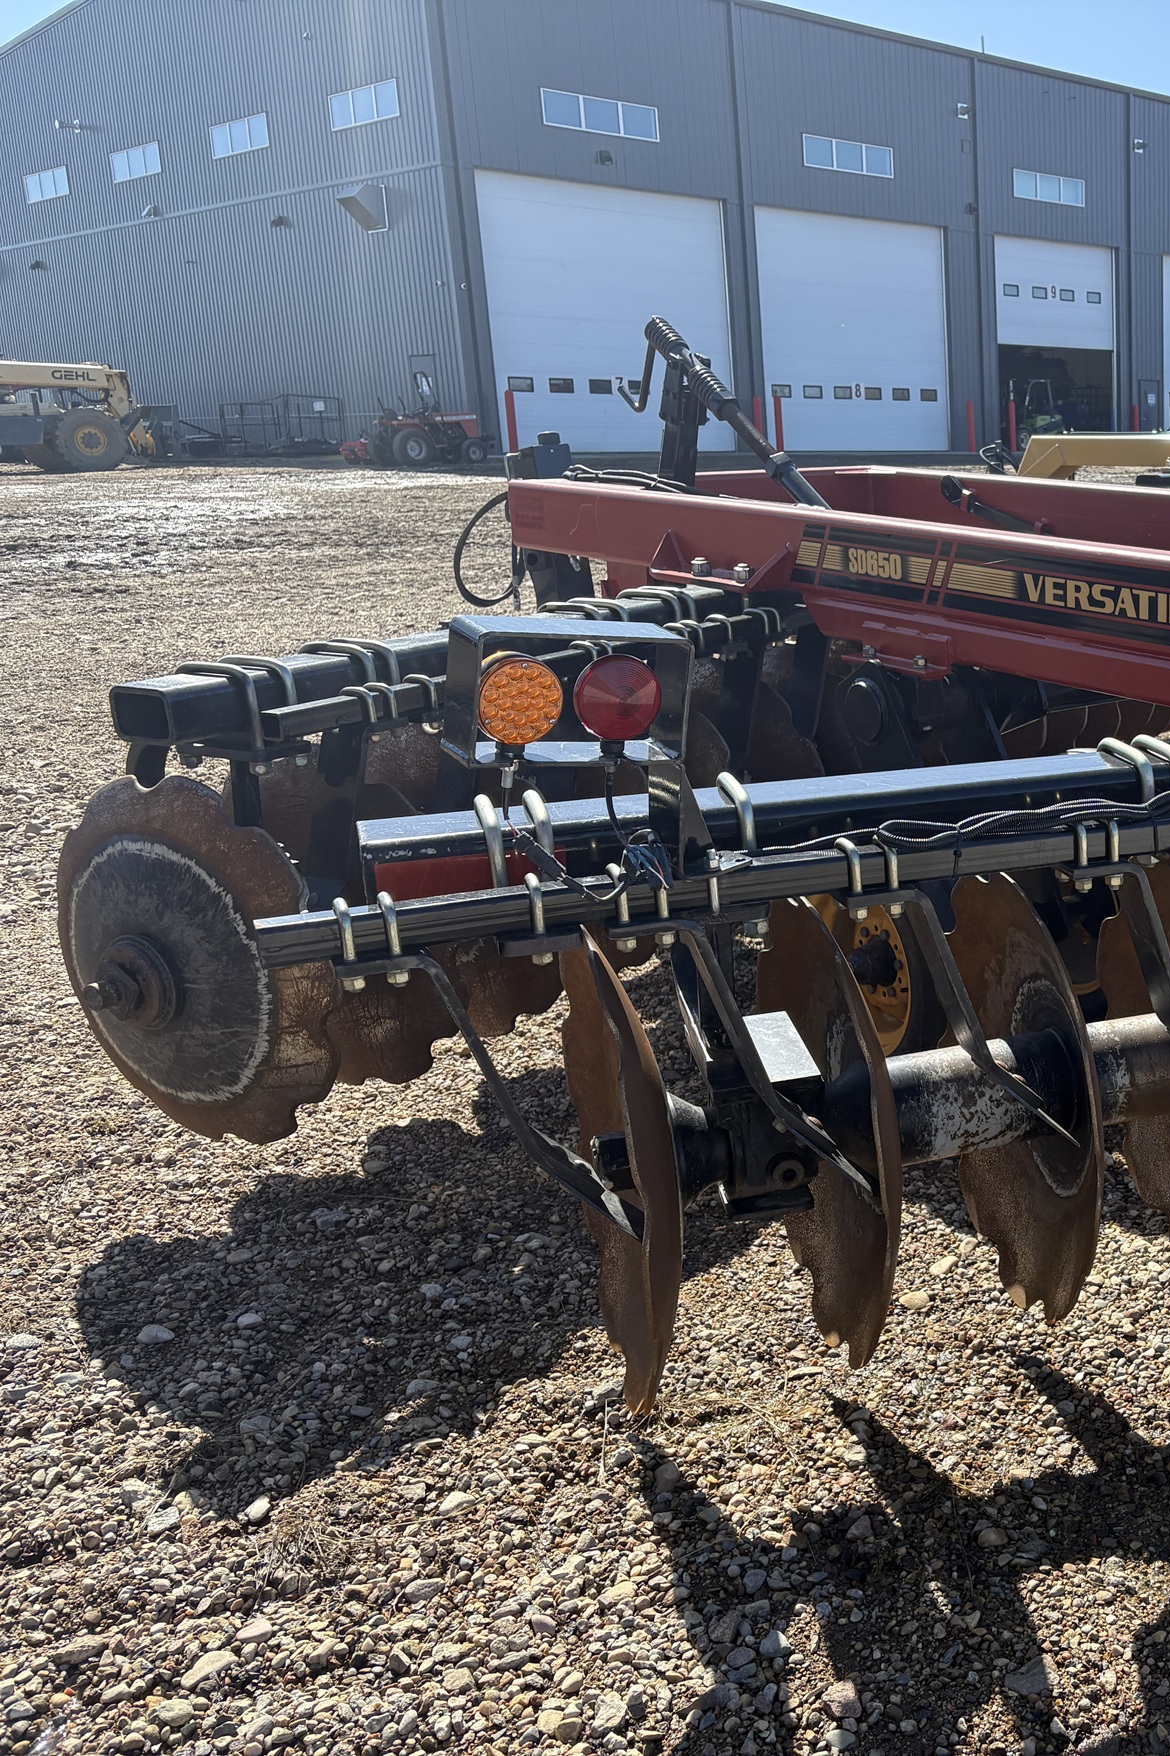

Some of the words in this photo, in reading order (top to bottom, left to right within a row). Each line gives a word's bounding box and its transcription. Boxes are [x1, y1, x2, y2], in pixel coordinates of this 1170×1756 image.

[1051, 285, 1057, 299] 9
[51, 369, 97, 382] GEHL
[854, 383, 862, 398] 8
[848, 547, 902, 580] SD650
